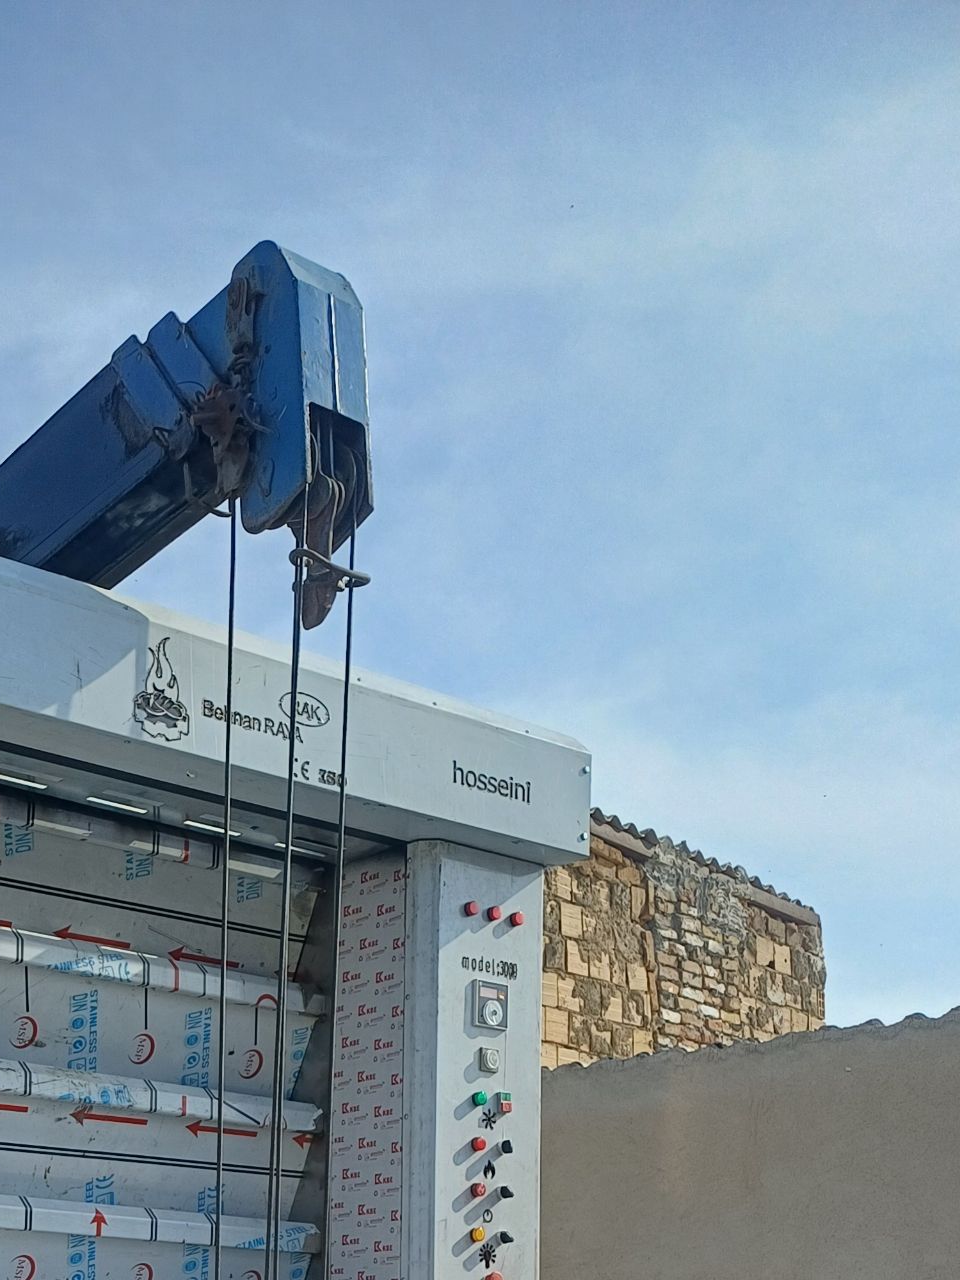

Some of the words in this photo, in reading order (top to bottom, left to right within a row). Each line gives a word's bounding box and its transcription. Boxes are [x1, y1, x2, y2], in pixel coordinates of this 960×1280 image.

[453, 760, 531, 804] hosseini
[72, 993, 88, 1012] DIN
[89, 989, 98, 1054] STAINLESS
[188, 1011, 203, 1029] DIN
[202, 1007, 212, 1069] STAINLESS
